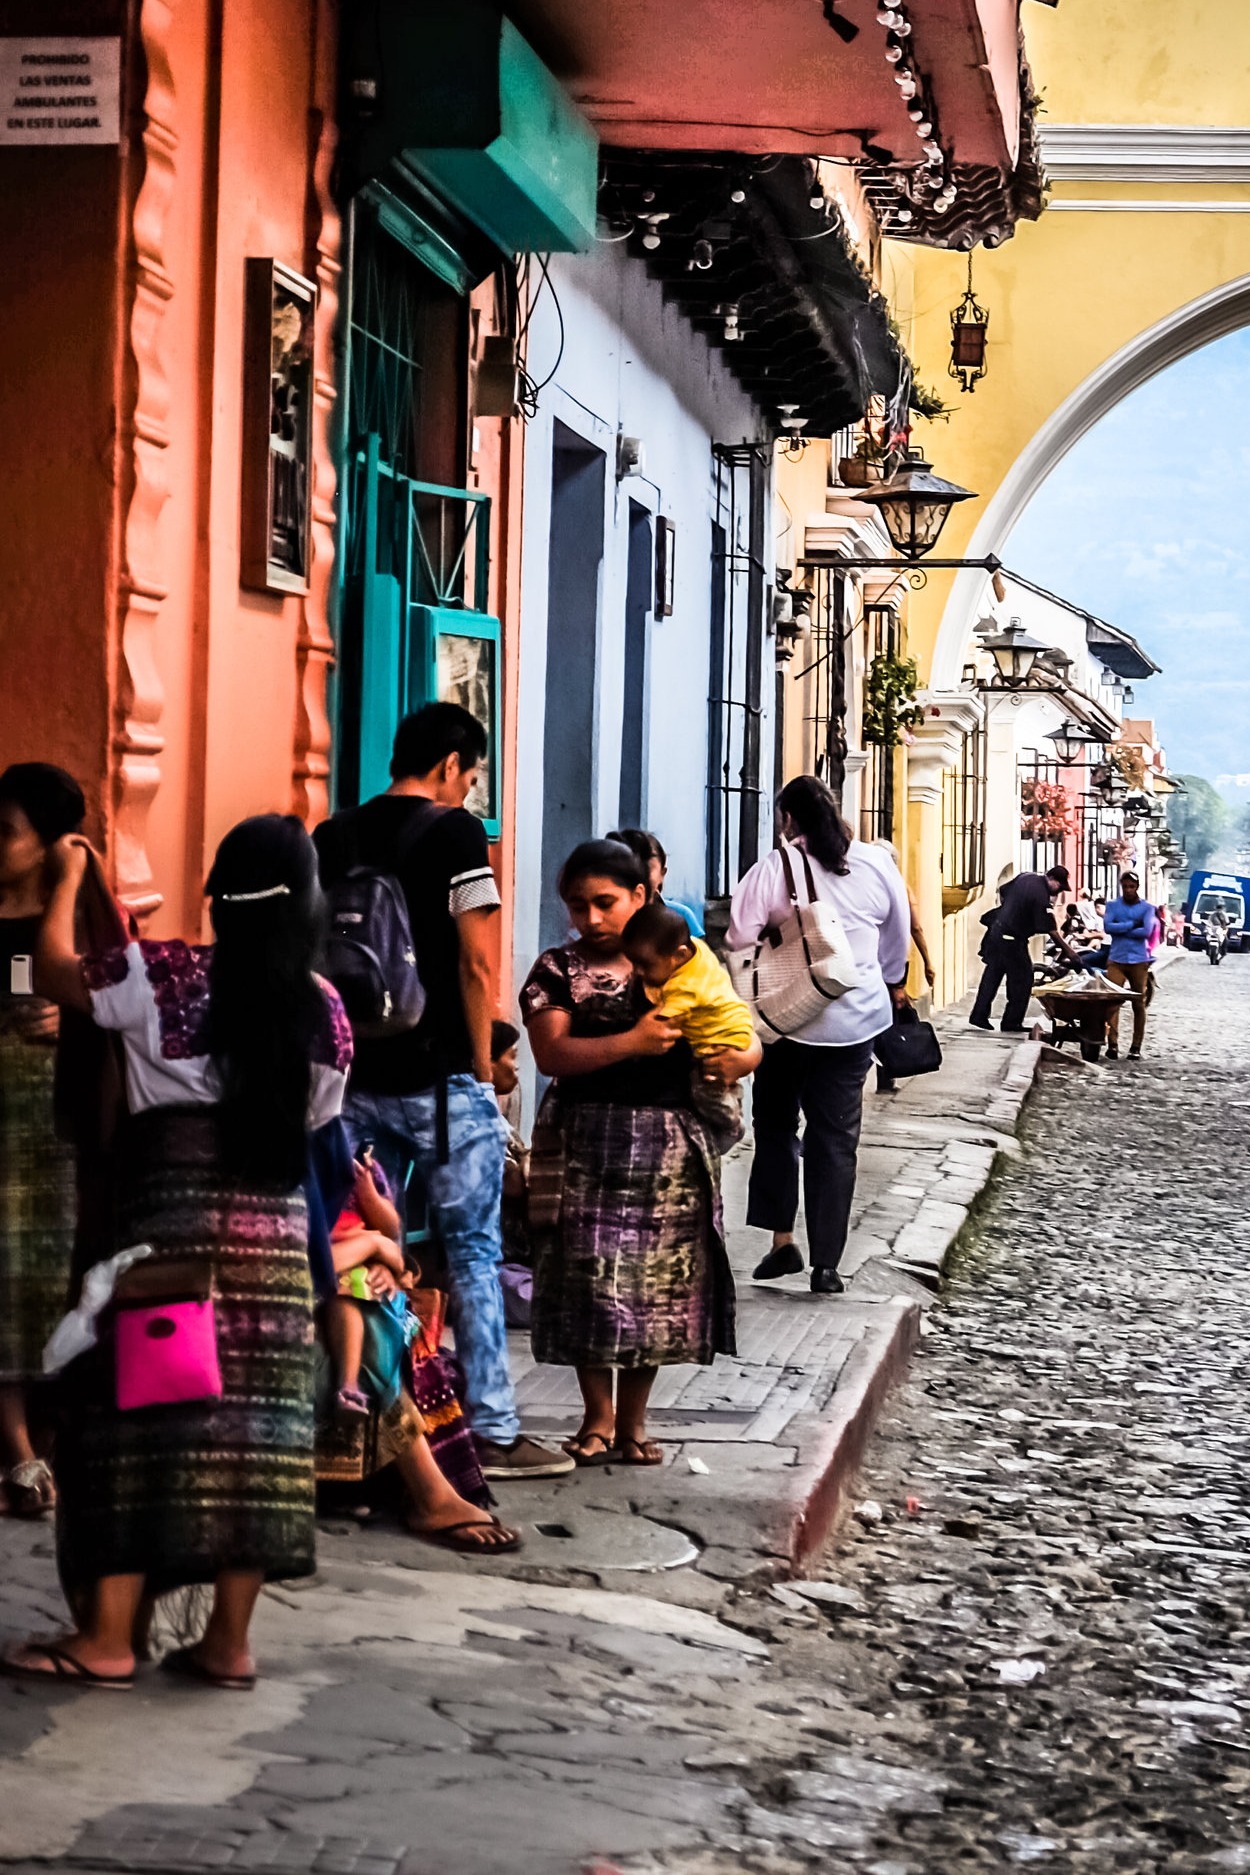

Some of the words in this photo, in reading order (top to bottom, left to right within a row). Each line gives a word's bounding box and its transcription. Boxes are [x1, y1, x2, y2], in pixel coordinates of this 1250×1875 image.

[21, 54, 90, 65] PROHIBIDO
[19, 75, 41, 86] LAS
[44, 75, 91, 86] VENTAS
[13, 96, 97, 107] AMBULANTES
[7, 117, 24, 129] EN
[26, 117, 55, 129] ESTE
